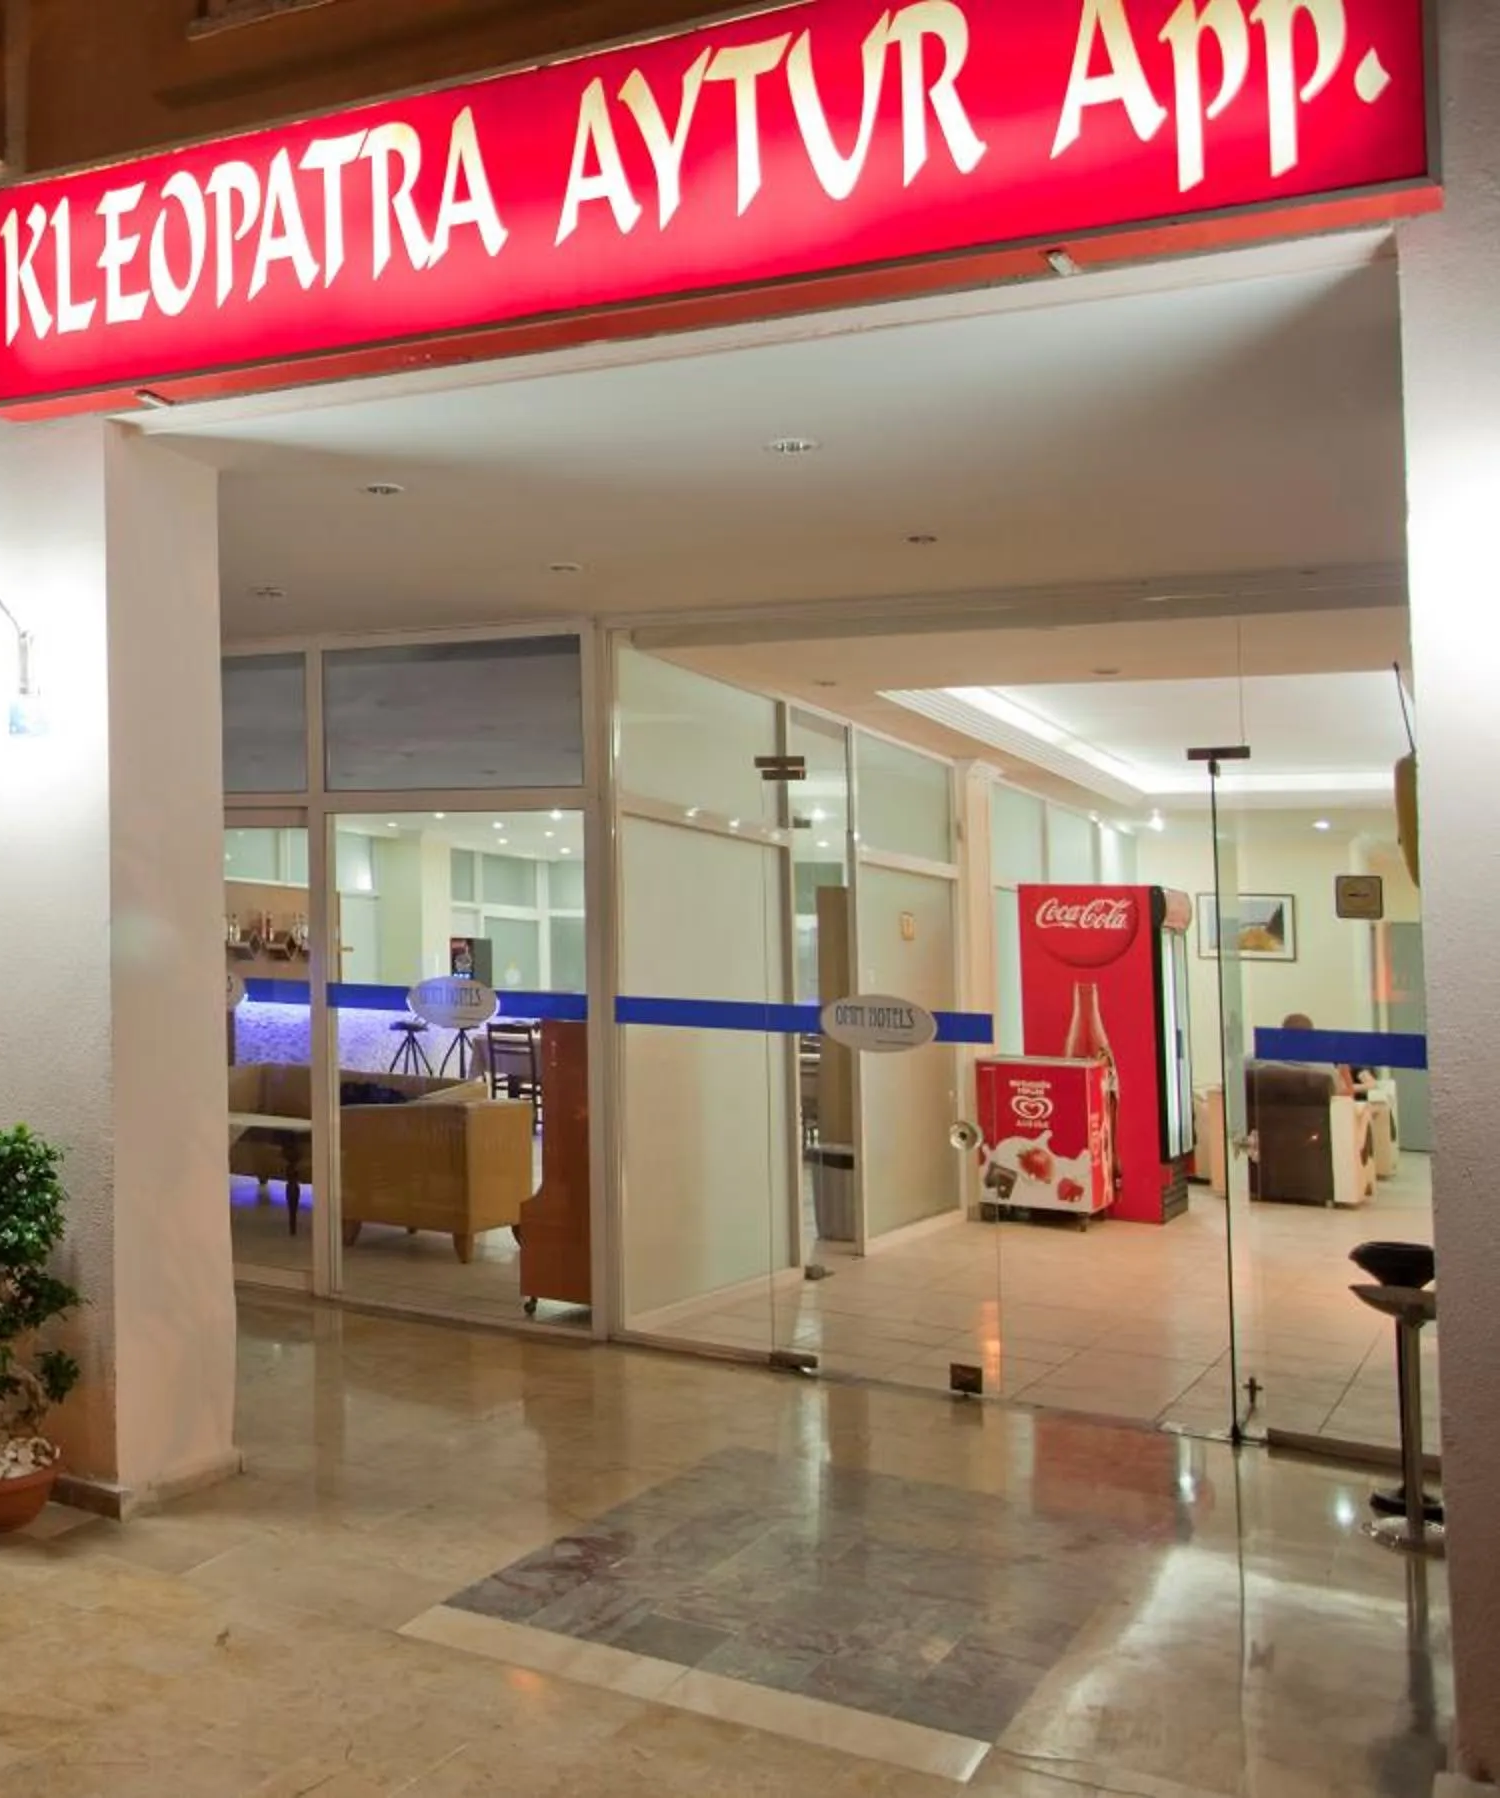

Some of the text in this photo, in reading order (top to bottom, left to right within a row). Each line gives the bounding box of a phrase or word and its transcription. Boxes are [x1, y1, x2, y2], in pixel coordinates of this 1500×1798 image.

[0, 0, 1392, 346] KLEOPATRA AYTUR App.
[868, 1007, 914, 1029] HOTELS
